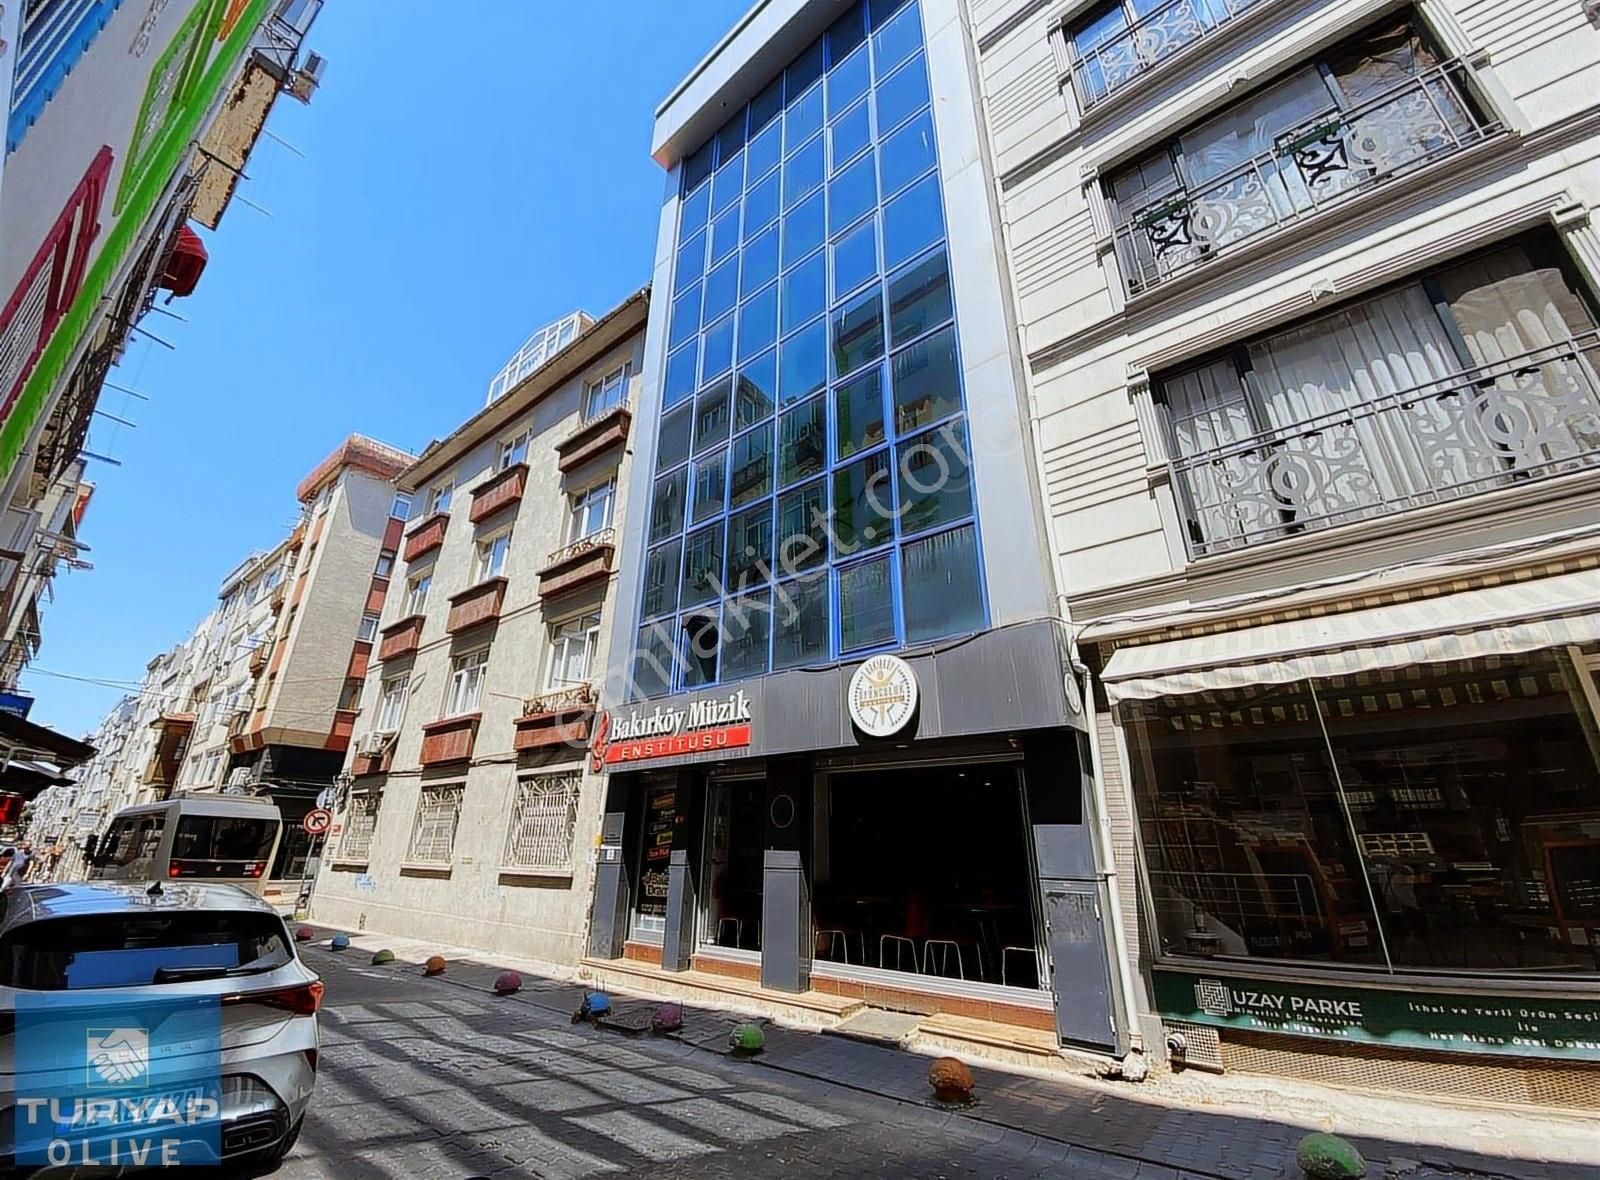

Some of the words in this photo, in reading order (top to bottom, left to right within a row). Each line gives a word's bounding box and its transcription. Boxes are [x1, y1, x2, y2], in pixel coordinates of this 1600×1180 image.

[686, 689, 751, 728] Müzik
[1232, 991, 1285, 1009] UZAY
[1290, 997, 1363, 1017] PARKE
